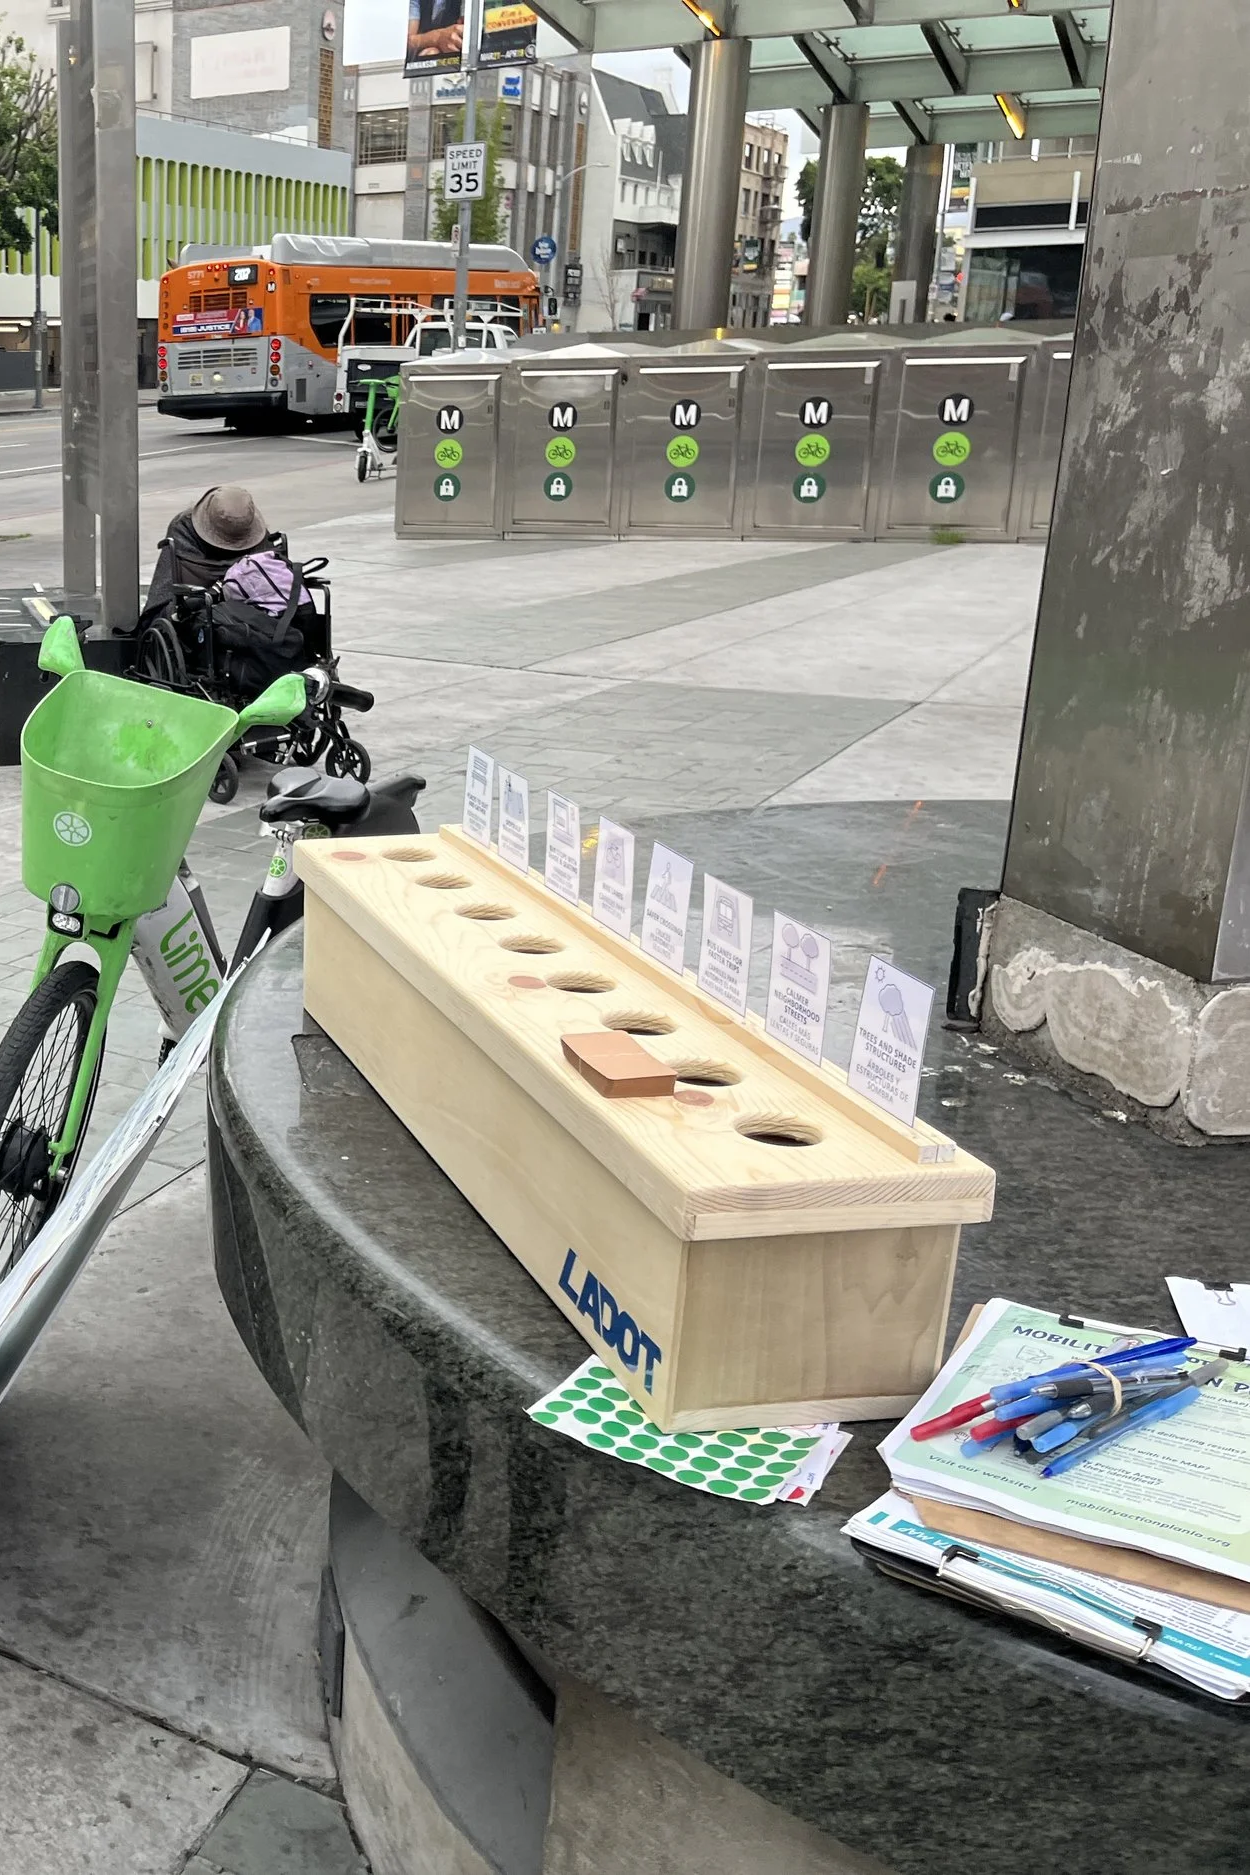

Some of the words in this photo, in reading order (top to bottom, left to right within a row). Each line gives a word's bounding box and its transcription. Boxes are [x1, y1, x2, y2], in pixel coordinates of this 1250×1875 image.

[449, 149, 482, 160] SPEED
[451, 161, 478, 171] LIMIT
[450, 172, 479, 193] 35
[439, 410, 461, 429] M
[553, 407, 574, 428] M
[674, 404, 697, 426] M
[804, 401, 828, 424] M
[943, 398, 969, 421] M
[707, 938, 716, 951] BUS
[716, 946, 732, 960] LANES
[732, 955, 743, 967] FOR
[708, 949, 725, 965] FASTER
[726, 960, 740, 974] TRIPS
[774, 989, 820, 1023] NEIGHBORHOOD
[786, 987, 809, 1006] CALMER
[779, 1015, 798, 1032] CALLES
[784, 1005, 807, 1025] STREETS
[794, 1034, 819, 1056] SEGURAS
[859, 1027, 877, 1044] TREES
[878, 1039, 893, 1054] AND
[894, 1049, 917, 1069] SHADE
[865, 1042, 906, 1073] STRUCTURES
[856, 1064, 899, 1097] ESTRUCTURAS
[899, 1091, 910, 1103] DE
[867, 1081, 894, 1104] SOMBRA
[558, 1247, 662, 1396] LADOT
[1012, 1325, 1106, 1354] MOBILIT
[1157, 1430, 1206, 1447] delivering
[1207, 1440, 1248, 1455] results?
[1094, 1461, 1134, 1476] Priority
[1137, 1450, 1161, 1459] with
[1161, 1455, 1179, 1463] the
[1180, 1460, 1212, 1472] MAP?
[929, 1454, 957, 1466] Visit
[957, 1464, 980, 1473] our
[982, 1471, 1038, 1492] website!
[1082, 1465, 1106, 1474] they
[1107, 1469, 1161, 1486] identified?
[897, 1527, 934, 1540] MAP
[1065, 1499, 1232, 1548] mobilityactionplanla.org
